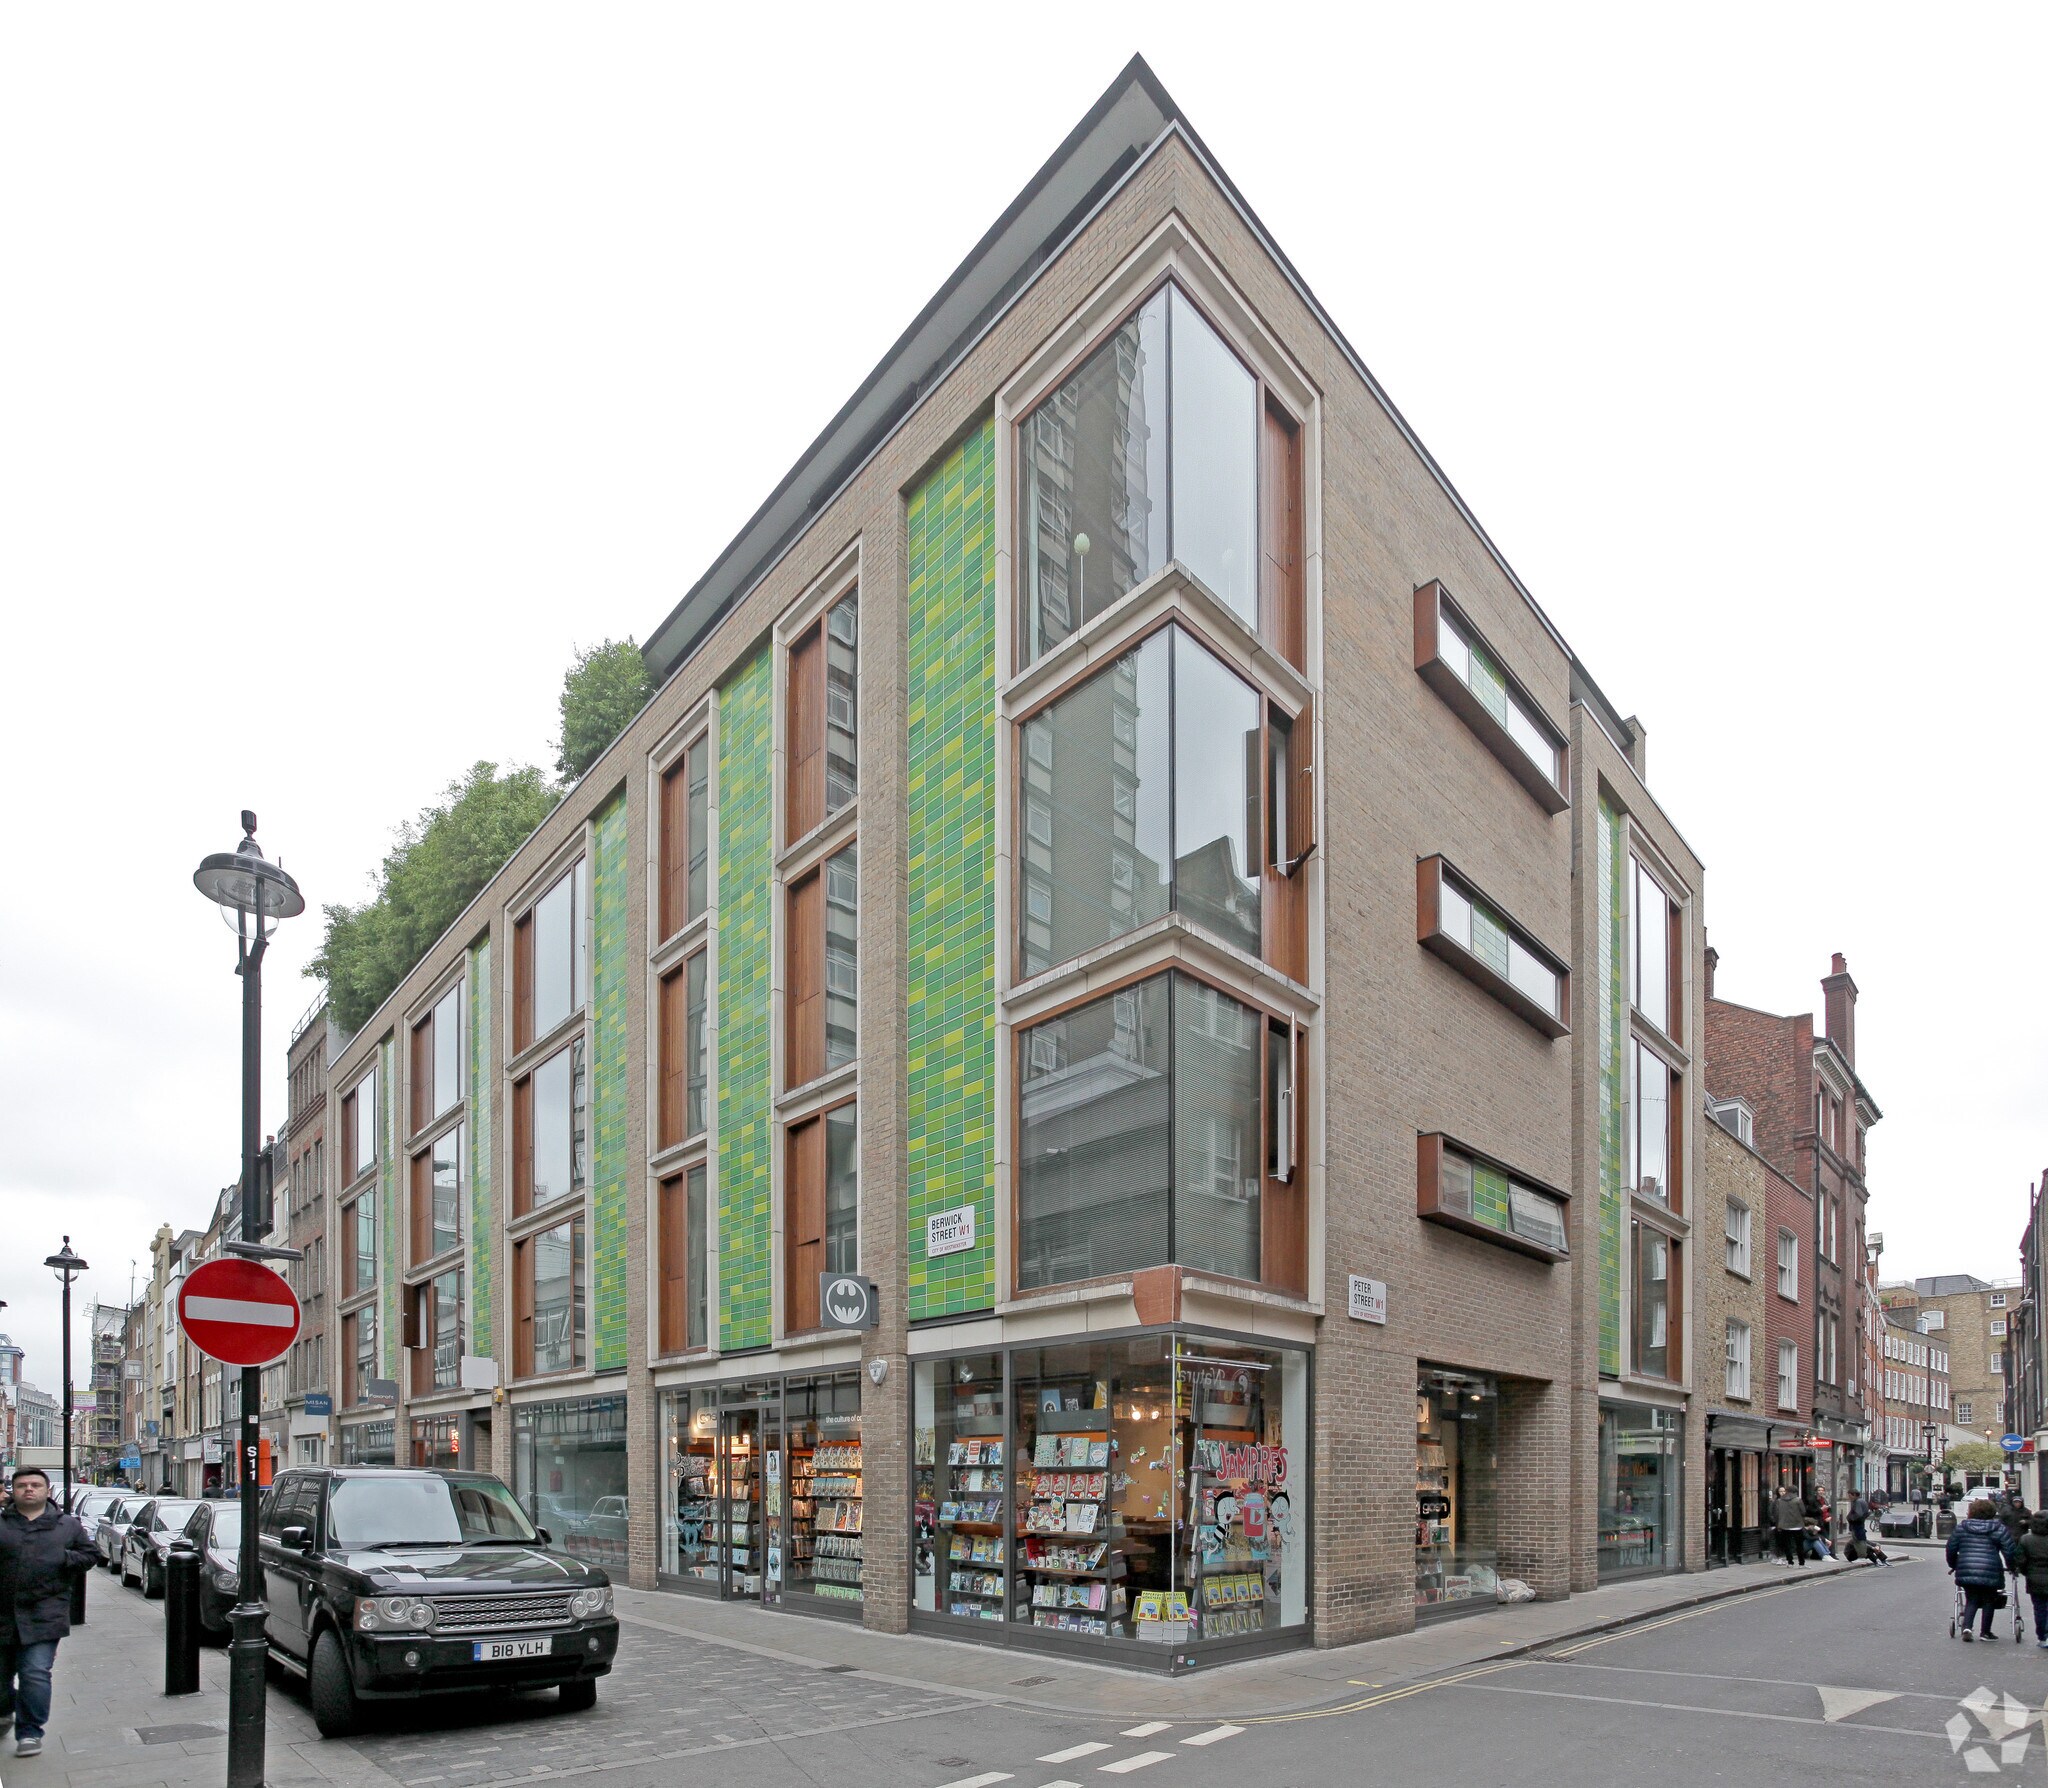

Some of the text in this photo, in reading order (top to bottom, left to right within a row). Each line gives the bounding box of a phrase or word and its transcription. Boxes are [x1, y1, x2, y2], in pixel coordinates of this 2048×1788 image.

[931, 1212, 963, 1230] BERWICK
[931, 1223, 970, 1243] STREET W1
[1353, 1280, 1372, 1294] PETER
[1353, 1293, 1384, 1310] STREET W1
[825, 1415, 833, 1424] the
[834, 1414, 850, 1423] culture
[851, 1413, 857, 1422] of
[518, 1641, 544, 1656] YLH
